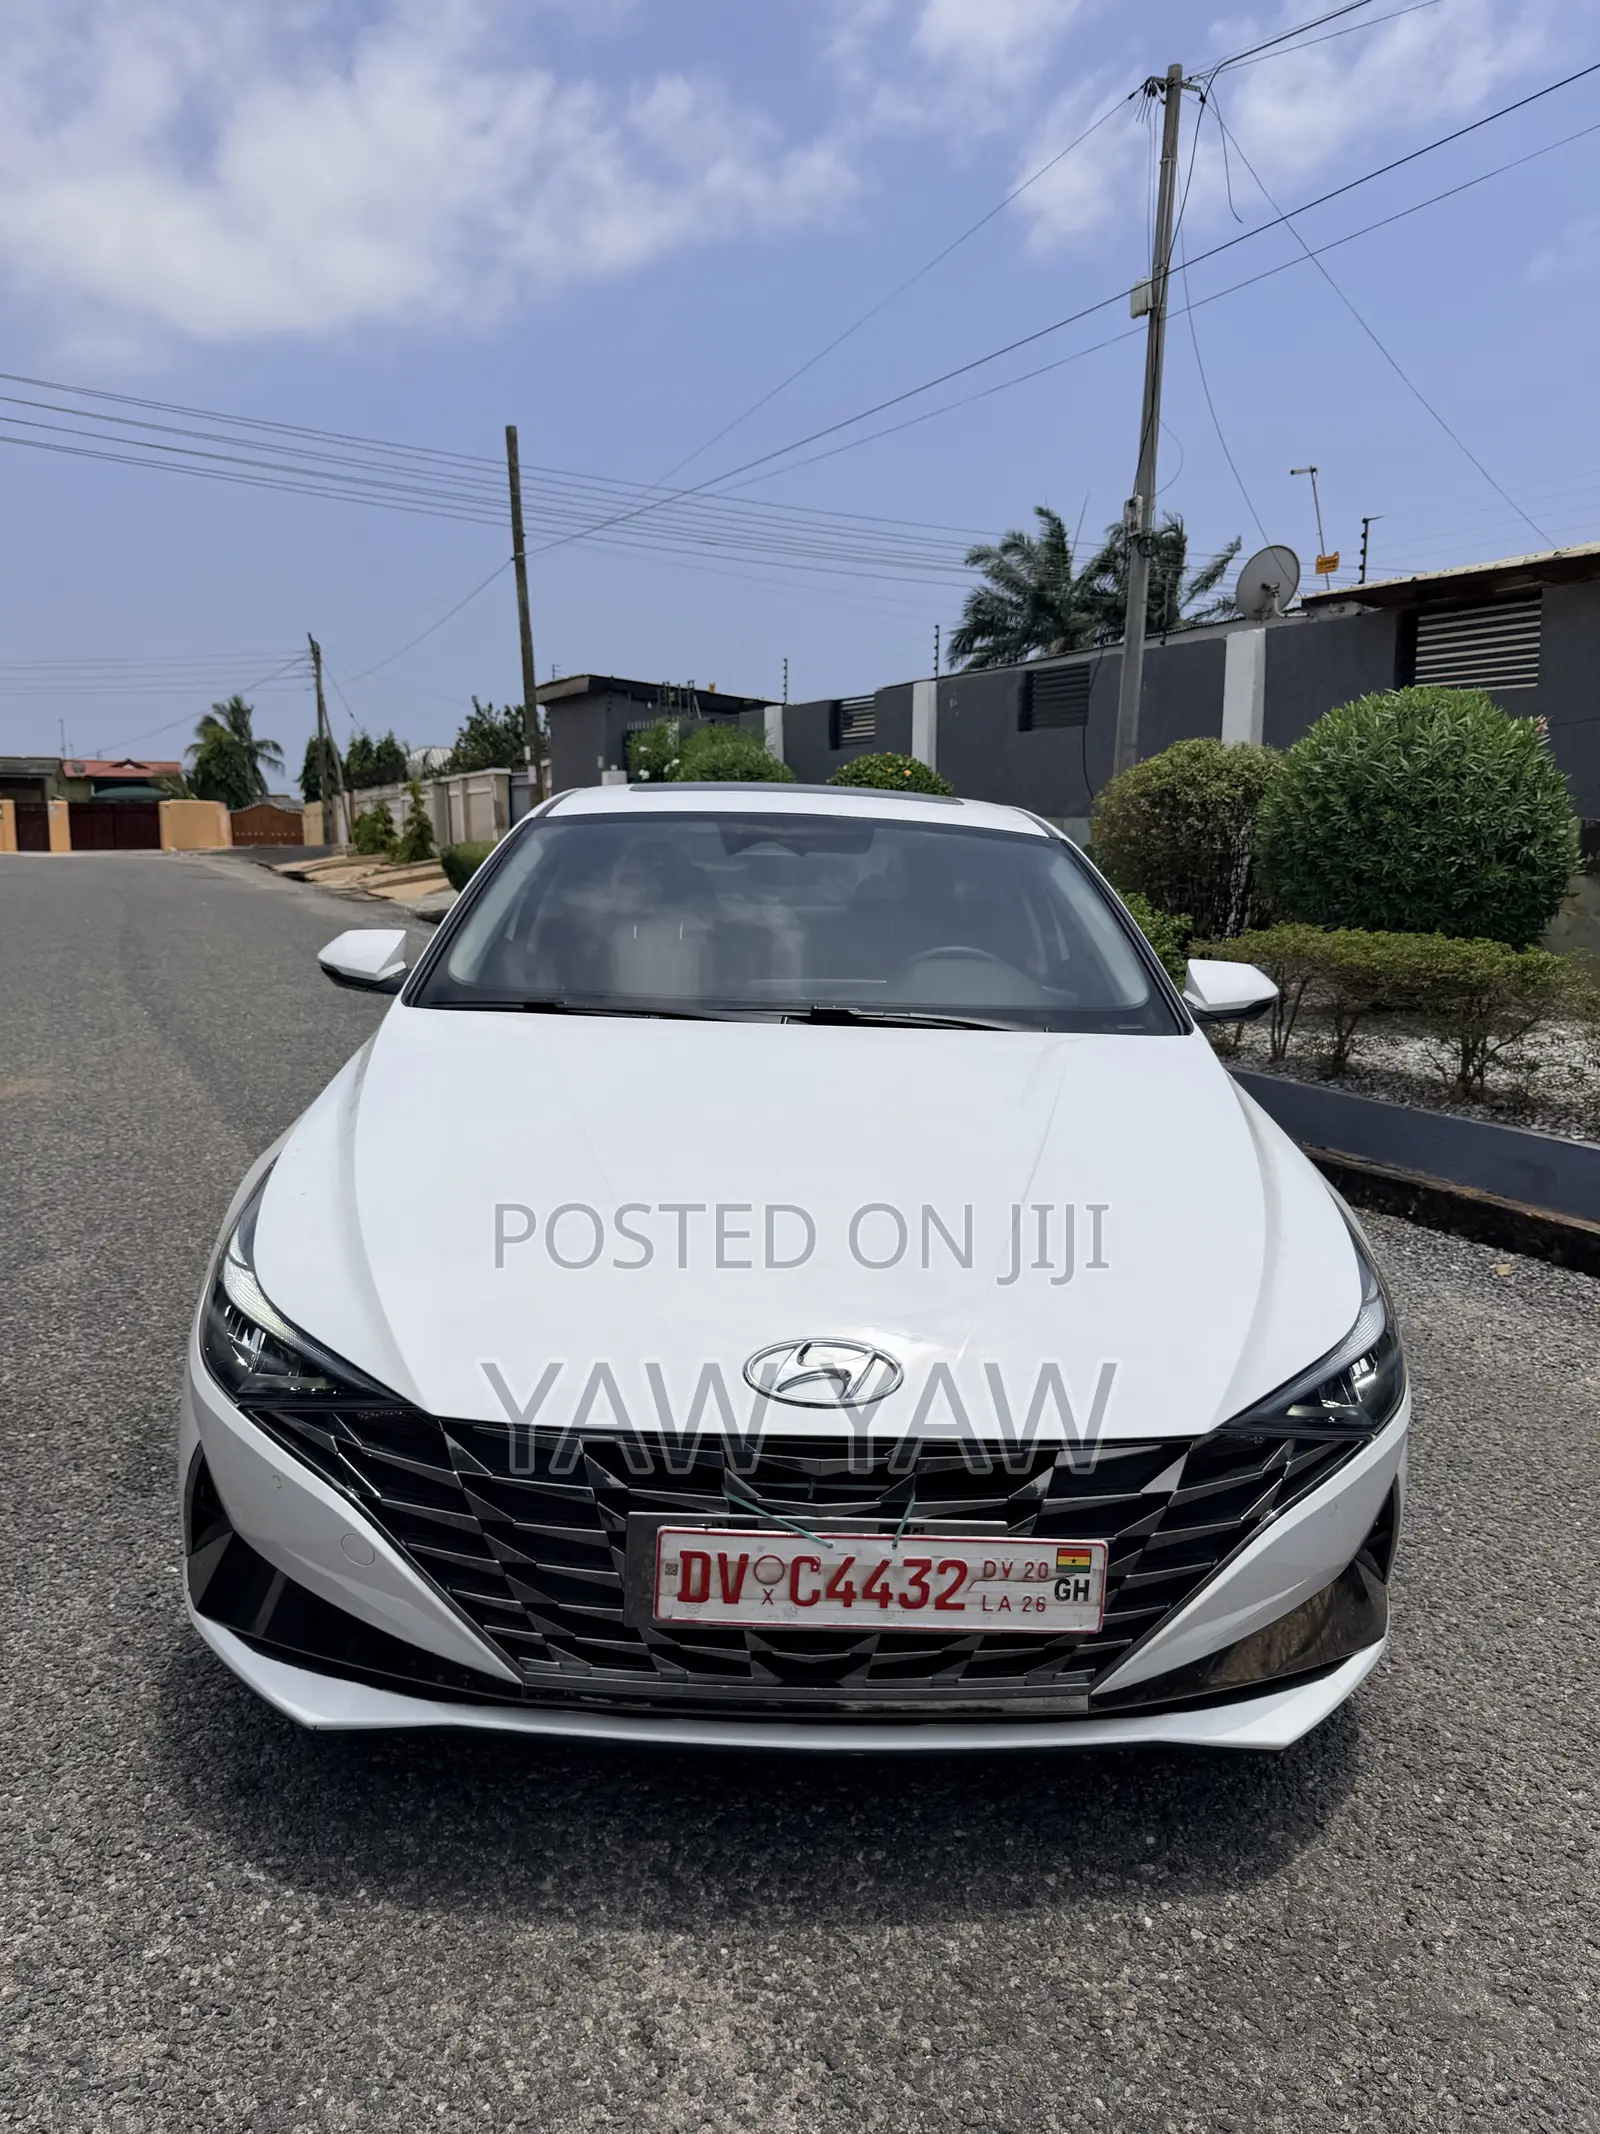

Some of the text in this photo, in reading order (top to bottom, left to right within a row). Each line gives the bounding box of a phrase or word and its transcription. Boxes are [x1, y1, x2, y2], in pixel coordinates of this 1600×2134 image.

[983, 1560, 1049, 1579] DV 20
[677, 1550, 968, 1611] DV C4432
[1054, 1578, 1090, 1602] GH
[982, 1595, 1046, 1612] LA 26
